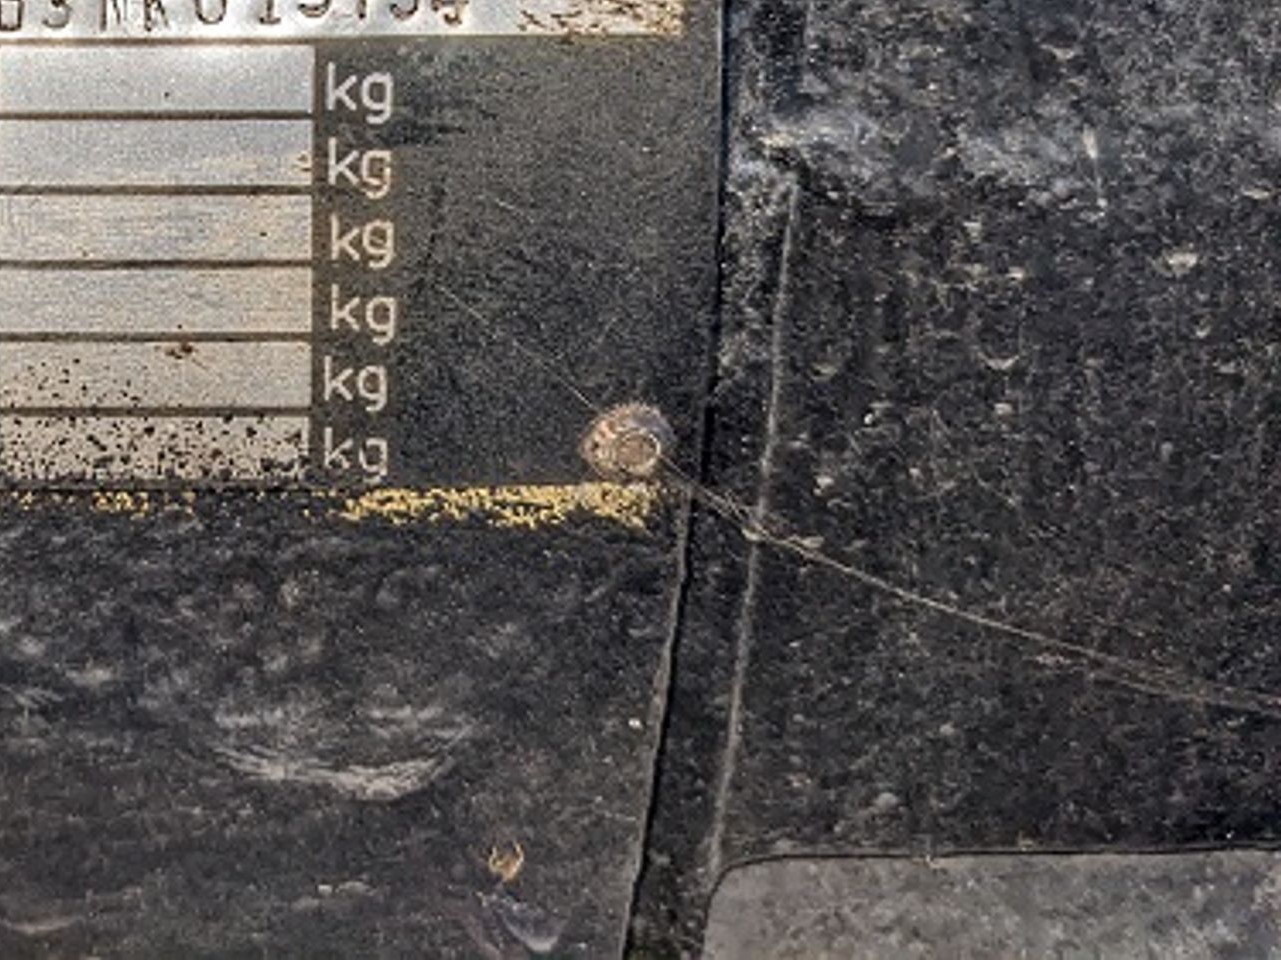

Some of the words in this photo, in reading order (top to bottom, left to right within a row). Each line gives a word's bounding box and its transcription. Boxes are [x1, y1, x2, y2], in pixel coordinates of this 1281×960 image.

[326, 62, 394, 125] kg
[326, 138, 393, 199] kg
[329, 213, 395, 268] kg
[330, 285, 398, 345] kg
[323, 356, 388, 412] kg
[322, 427, 388, 485] kg
